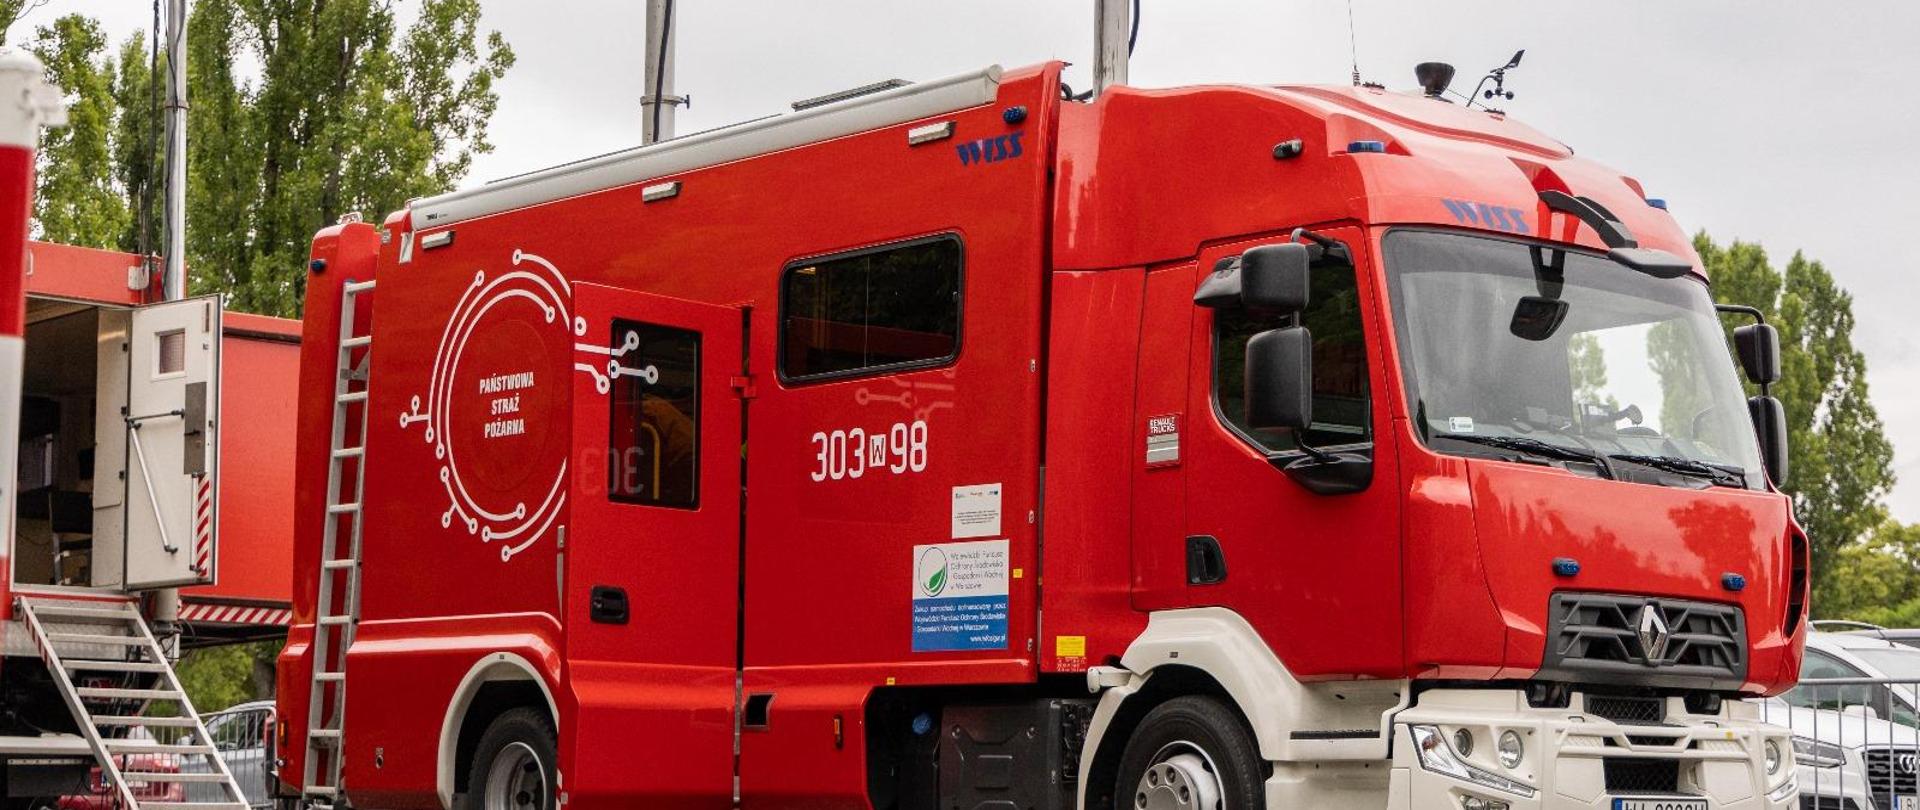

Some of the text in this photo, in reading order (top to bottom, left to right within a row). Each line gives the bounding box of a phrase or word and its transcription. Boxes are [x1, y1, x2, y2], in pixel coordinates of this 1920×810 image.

[956, 130, 1024, 166] WISS
[1441, 198, 1529, 232] WISS
[479, 371, 535, 395] PAŃSTWOWA
[491, 393, 520, 415] STRAŻ
[484, 416, 525, 439] POŻARNA
